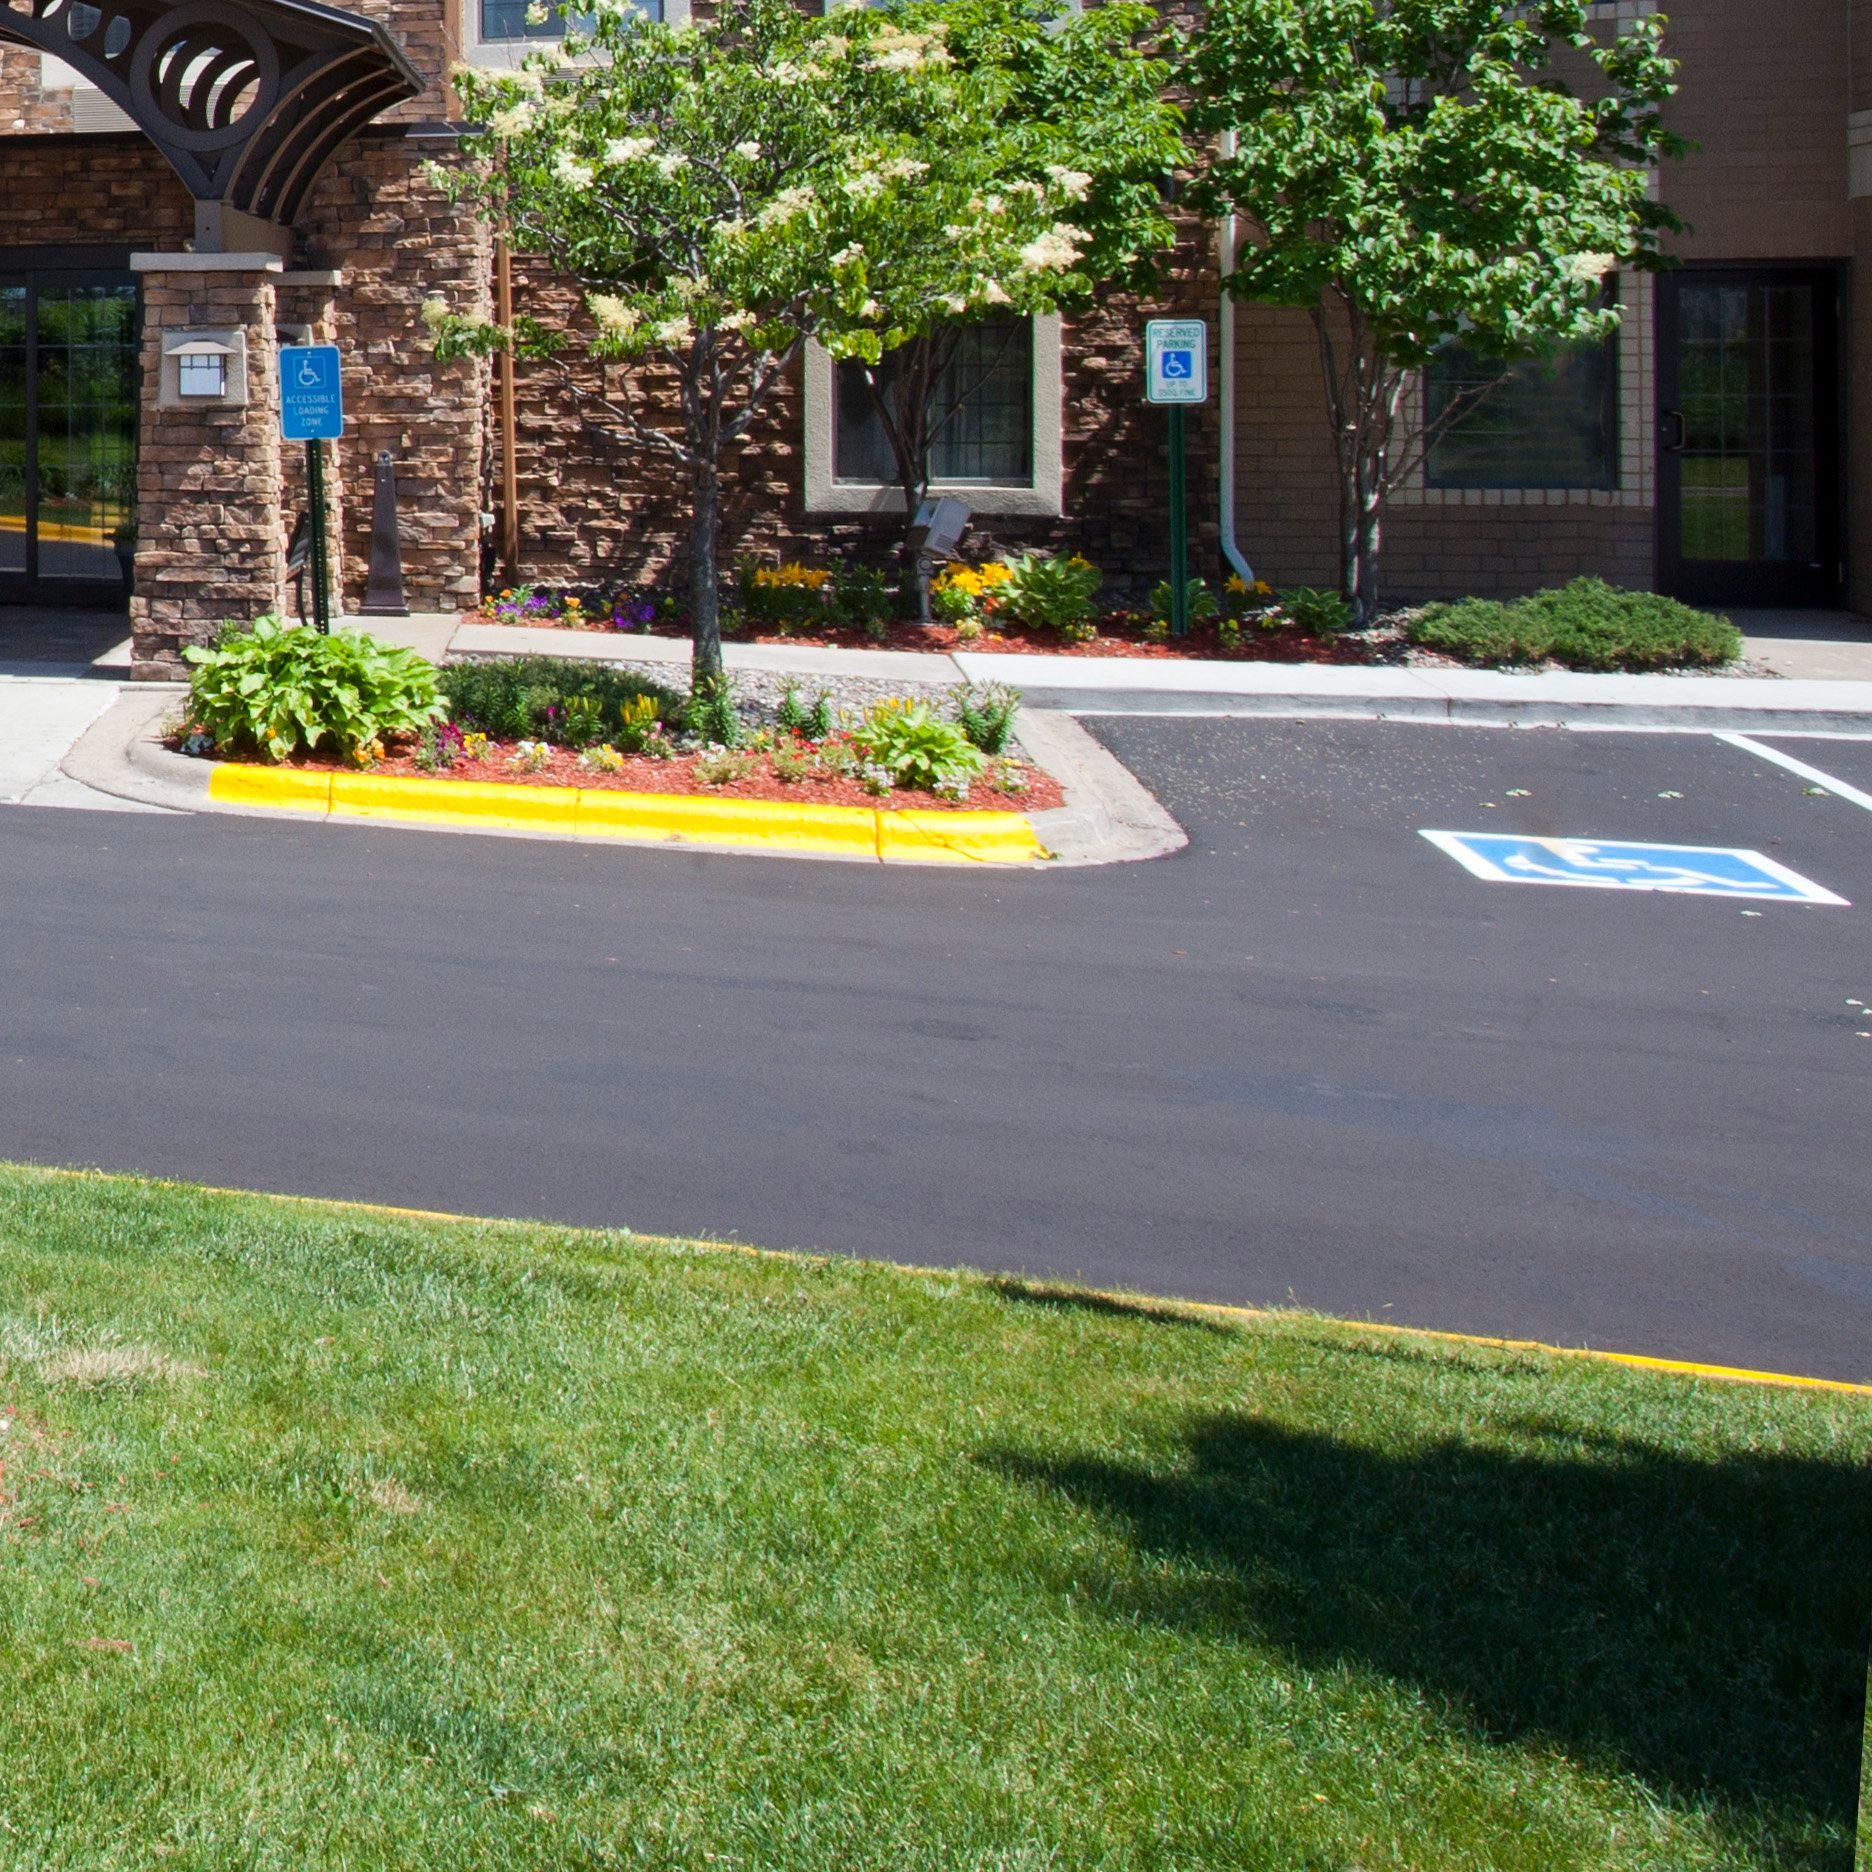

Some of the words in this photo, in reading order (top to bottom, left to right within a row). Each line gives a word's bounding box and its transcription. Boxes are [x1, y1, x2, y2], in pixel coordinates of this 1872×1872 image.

[1157, 339, 1197, 348] PARKING
[286, 394, 335, 404] ACCESSIBLE
[293, 406, 329, 415] LOADING
[301, 418, 322, 427] ZONE
